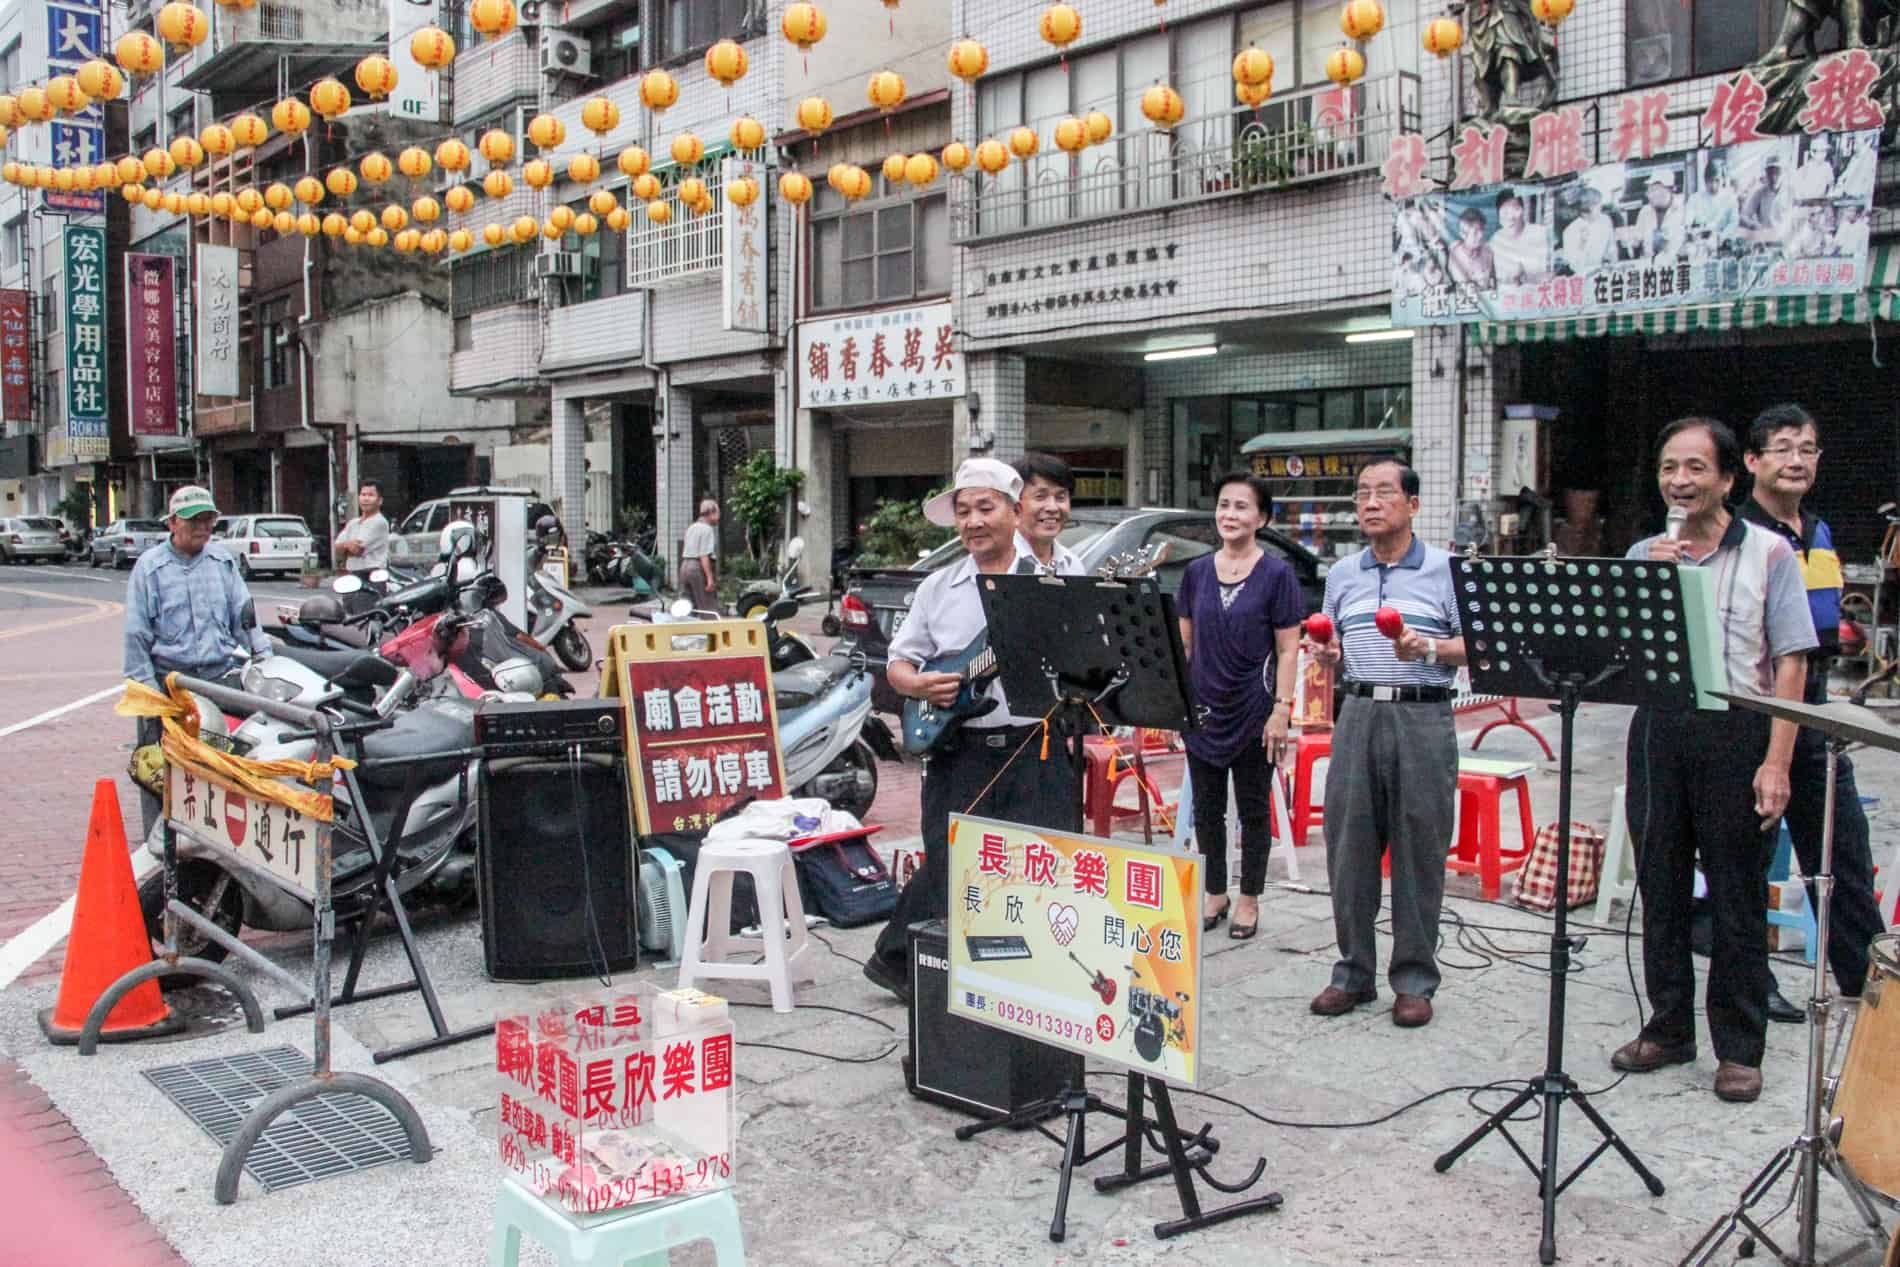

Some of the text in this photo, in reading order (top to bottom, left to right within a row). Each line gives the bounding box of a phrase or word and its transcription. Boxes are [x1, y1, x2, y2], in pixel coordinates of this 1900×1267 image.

[1384, 50, 1885, 198] 魏俊邦雕刻社
[1593, 255, 1692, 304] 在台灣的故事
[70, 233, 103, 413] 宏光學用品社
[643, 682, 763, 731] 廟會活動
[652, 750, 773, 803] 請勿停車
[978, 833, 1163, 910] 長欣樂團
[997, 1000, 1093, 1045] 0929133978
[583, 1034, 732, 1120] 長欣樂團
[587, 1152, 731, 1214] 0929-133-978
